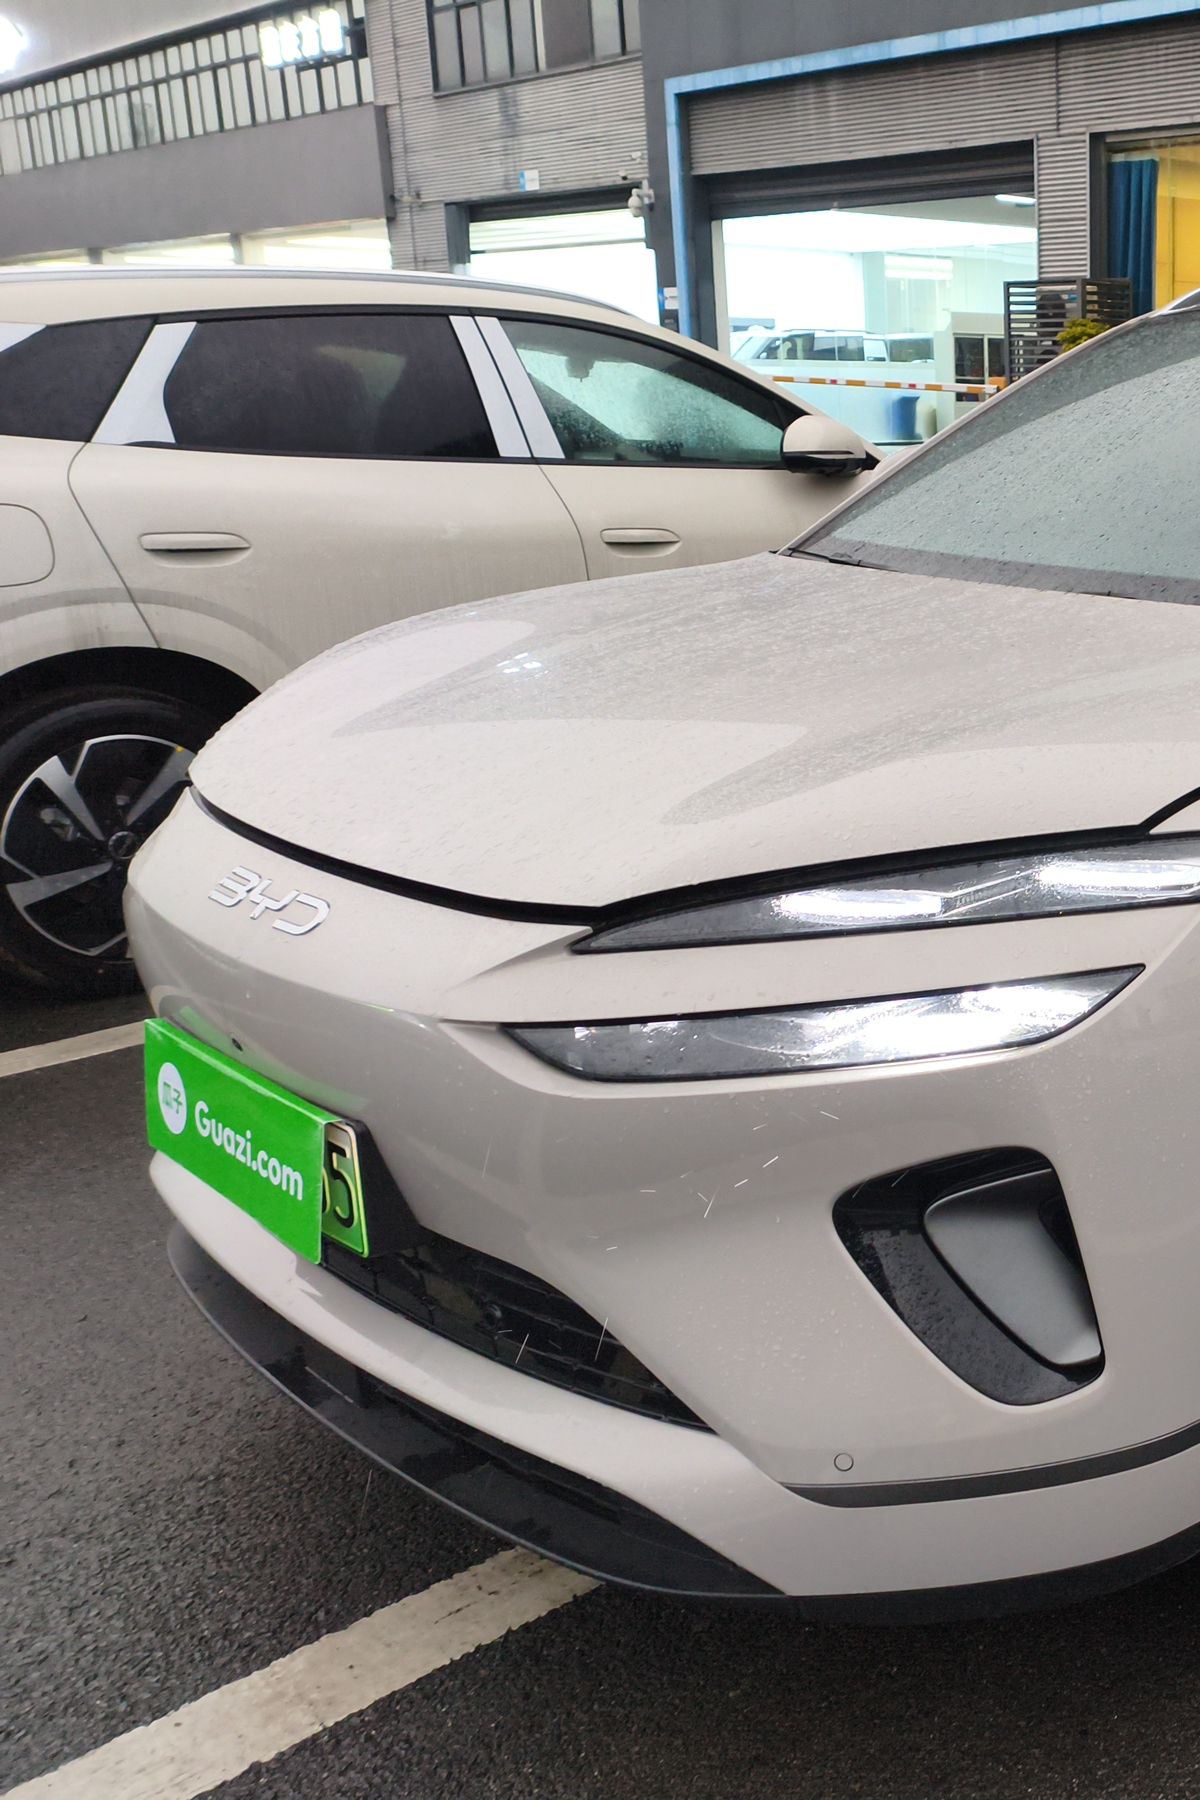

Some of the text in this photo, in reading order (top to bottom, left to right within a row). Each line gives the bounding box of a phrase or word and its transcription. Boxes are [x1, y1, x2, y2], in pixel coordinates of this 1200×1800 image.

[207, 865, 331, 936] BYD
[194, 1100, 304, 1201] Guazi.com
[321, 1140, 355, 1229] 5
